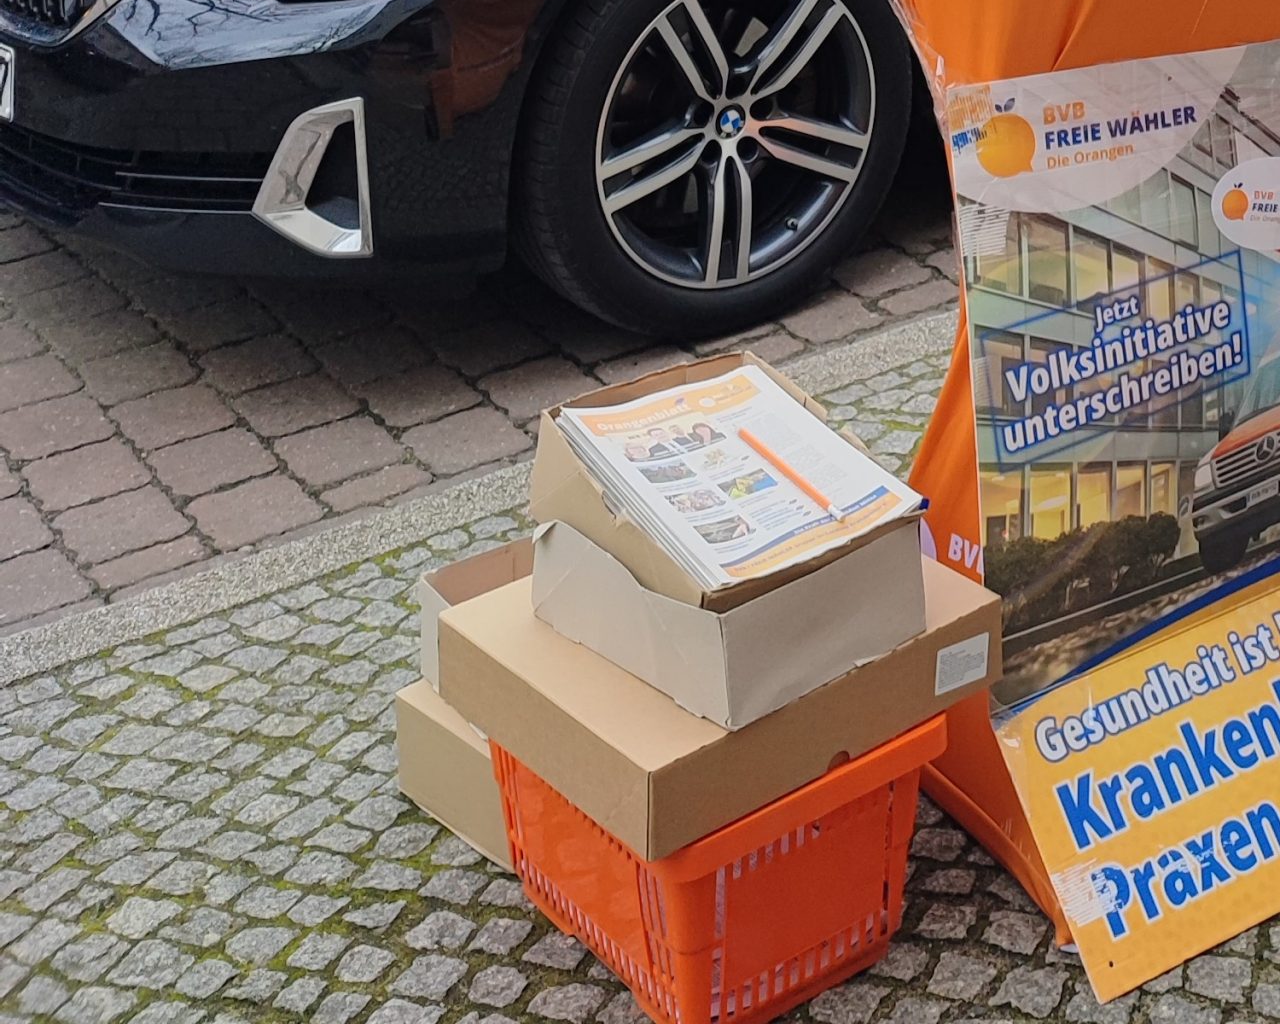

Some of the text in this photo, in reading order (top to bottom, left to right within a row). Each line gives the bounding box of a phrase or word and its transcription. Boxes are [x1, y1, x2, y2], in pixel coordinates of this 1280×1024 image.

[1042, 101, 1085, 125] BVB
[1045, 106, 1197, 150] FREIE WÄHLER
[1046, 144, 1134, 170] Die Orangen
[1252, 202, 1278, 213] FREIE
[1253, 190, 1274, 201] BVB
[1095, 296, 1139, 332] Jetzt
[1005, 301, 1230, 402] Volksinitiative
[1004, 333, 1242, 452] unterschreiben!
[1035, 646, 1234, 762] Gesundheit
[1228, 625, 1280, 675] ist
